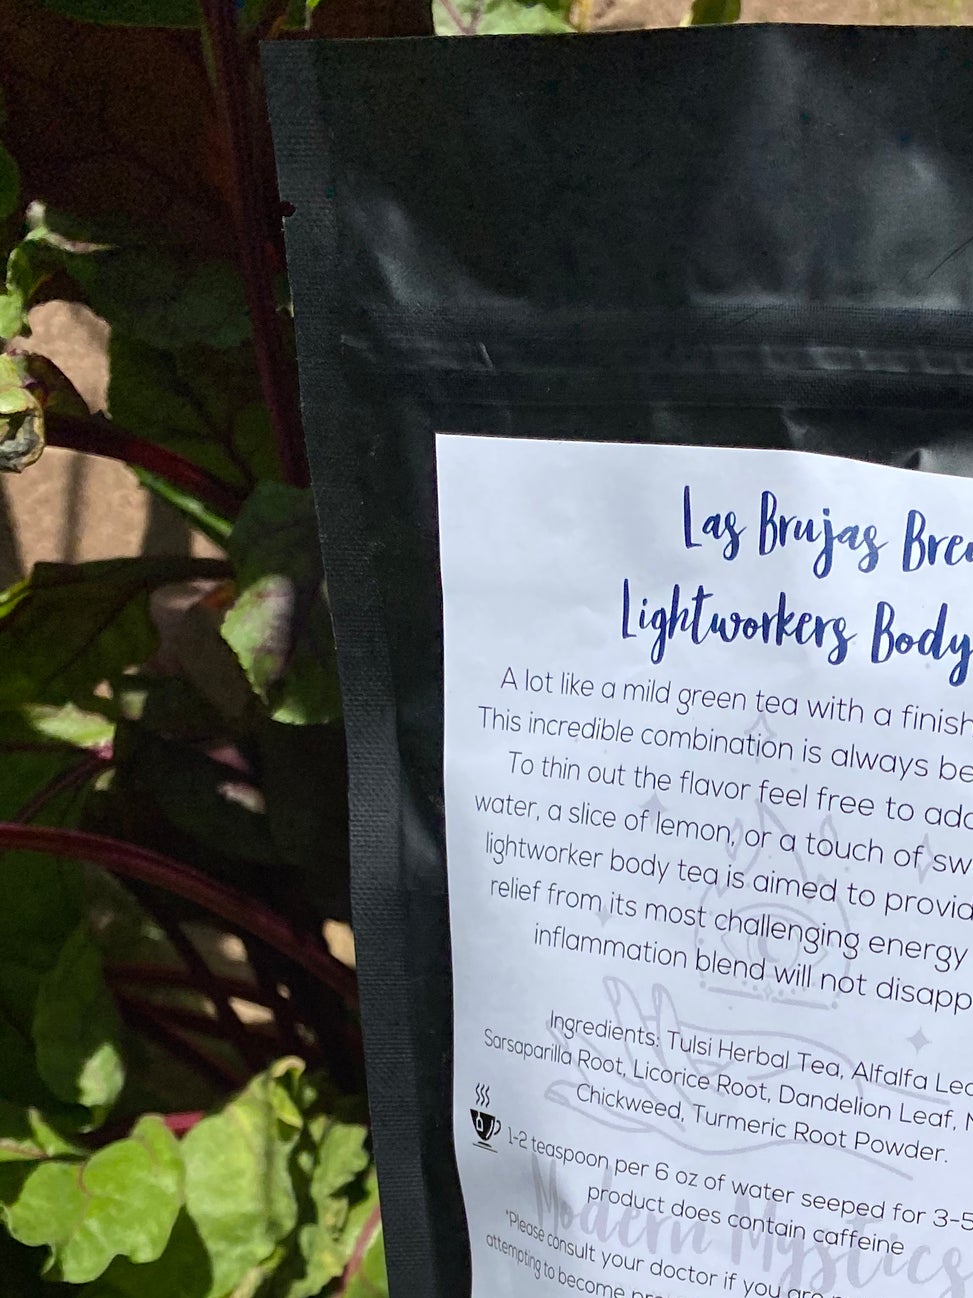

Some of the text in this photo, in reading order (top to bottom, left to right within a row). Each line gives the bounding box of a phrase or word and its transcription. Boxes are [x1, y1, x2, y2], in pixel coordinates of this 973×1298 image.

[683, 485, 747, 561] Las
[758, 490, 888, 580] Brujas
[621, 578, 857, 666] Lightworkers
[500, 666, 518, 691] A
[525, 668, 554, 694] lot
[560, 671, 595, 697] like
[601, 681, 616, 700] a
[623, 678, 672, 704] mild
[676, 688, 747, 716] green
[755, 689, 798, 716] tea
[807, 695, 864, 724] with
[873, 707, 892, 727] a
[478, 705, 521, 733] This
[528, 710, 634, 743] incredible
[640, 726, 794, 761] combination
[802, 737, 822, 764] is
[830, 743, 929, 782] always
[508, 750, 534, 776] To
[541, 755, 581, 781] thin
[587, 764, 627, 787] out
[633, 764, 672, 792] the
[679, 769, 752, 801] flavor
[758, 779, 808, 809] feel
[816, 785, 875, 817] free
[885, 795, 915, 822] to
[474, 794, 540, 822] water,
[547, 803, 562, 822] a
[568, 801, 617, 829] slice
[624, 808, 650, 833] of
[655, 810, 735, 847] lemon,
[744, 828, 773, 849] or
[779, 833, 797, 853] a
[805, 832, 884, 865] touch
[893, 844, 925, 869] of
[486, 831, 604, 869] lightworker
[609, 847, 671, 885] body
[677, 858, 719, 886] tea
[726, 863, 745, 890] is
[752, 869, 838, 903] aimed
[846, 882, 876, 908] to
[490, 876, 542, 903] relief
[547, 882, 602, 913] from
[609, 893, 637, 918] its
[644, 902, 707, 929] most
[714, 908, 860, 961] challenging
[868, 935, 969, 973] energy
[534, 925, 687, 969] inflammation
[695, 946, 766, 981] blend
[773, 962, 812, 989] will
[820, 972, 868, 997] not
[484, 1028, 573, 1065] Sarsaparilla
[577, 1048, 626, 1079] Root,
[633, 1058, 711, 1091] Licorice
[716, 1073, 771, 1104] Root,
[778, 1083, 892, 1121] Dandelion
[899, 1102, 957, 1131] Leaf,
[550, 1009, 660, 1048] Ingredients:
[667, 1029, 712, 1057] Tulsi
[718, 1038, 790, 1070] Herbal
[797, 1051, 844, 1081] Tea,
[850, 1060, 928, 1091] Alfalfa
[576, 1082, 947, 1162] Chickweed, Turmeric Root Powder.
[508, 1126, 528, 1151] 1-2
[532, 1140, 609, 1171] teaspoon
[614, 1158, 650, 1177] per
[655, 1161, 670, 1181] 6
[675, 1170, 699, 1188] oz
[703, 1173, 727, 1192] of
[731, 1180, 796, 1204] water
[800, 1193, 886, 1220] seeped
[892, 1202, 927, 1225] for
[530, 1154, 715, 1258] Modern
[486, 1234, 542, 1280] attempting
[543, 1260, 555, 1280] to
[587, 1185, 905, 1256] product does contain caffeine
[547, 1233, 596, 1263] consult
[601, 1251, 645, 1272] your
[649, 1258, 719, 1287] doctor
[723, 1272, 738, 1291] if
